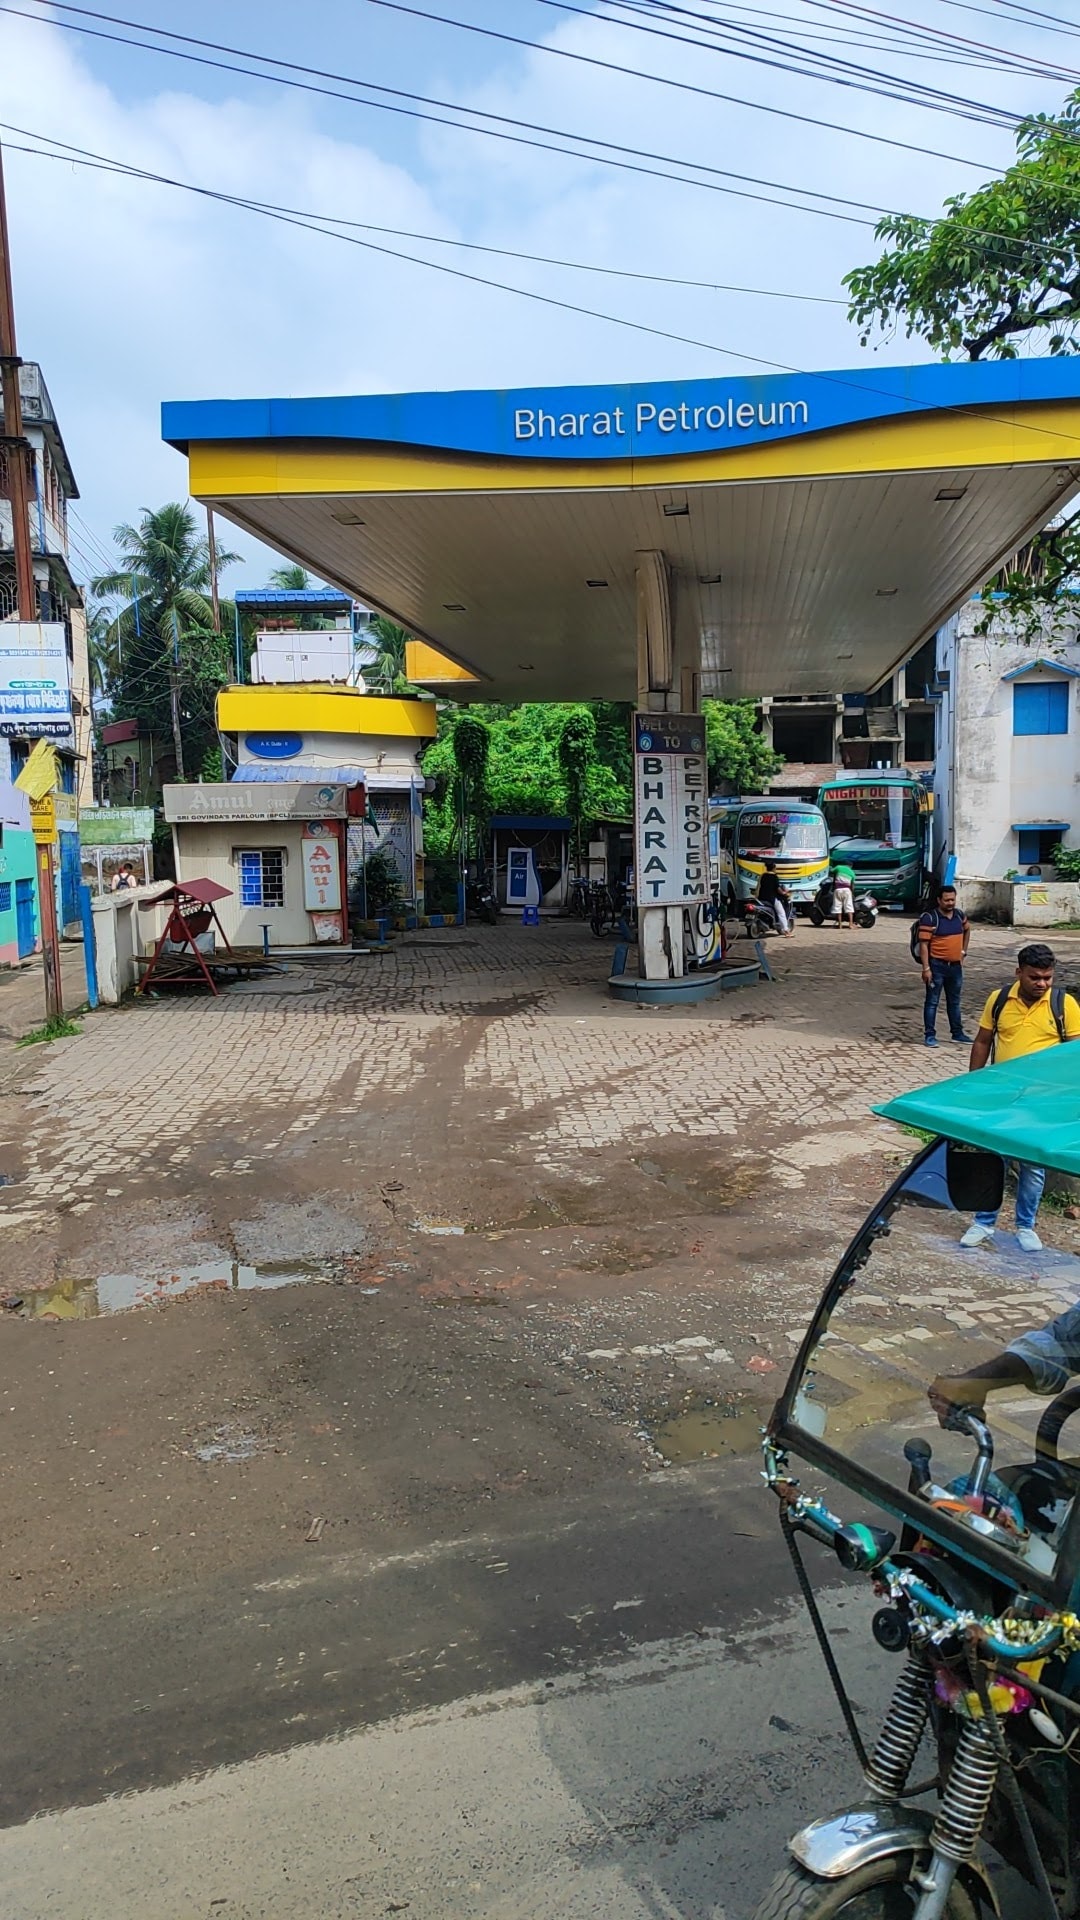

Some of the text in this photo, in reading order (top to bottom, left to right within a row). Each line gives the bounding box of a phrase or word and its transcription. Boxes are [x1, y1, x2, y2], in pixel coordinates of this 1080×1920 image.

[515, 398, 808, 439] Bharat Petroleum
[663, 735, 681, 749] TO
[190, 790, 254, 810] Amul
[825, 788, 865, 800] NIGHT
[643, 757, 667, 898] BHARAT
[682, 757, 705, 896] PETROLEUM
[308, 845, 333, 905] Amul
[514, 872, 524, 880] Air
